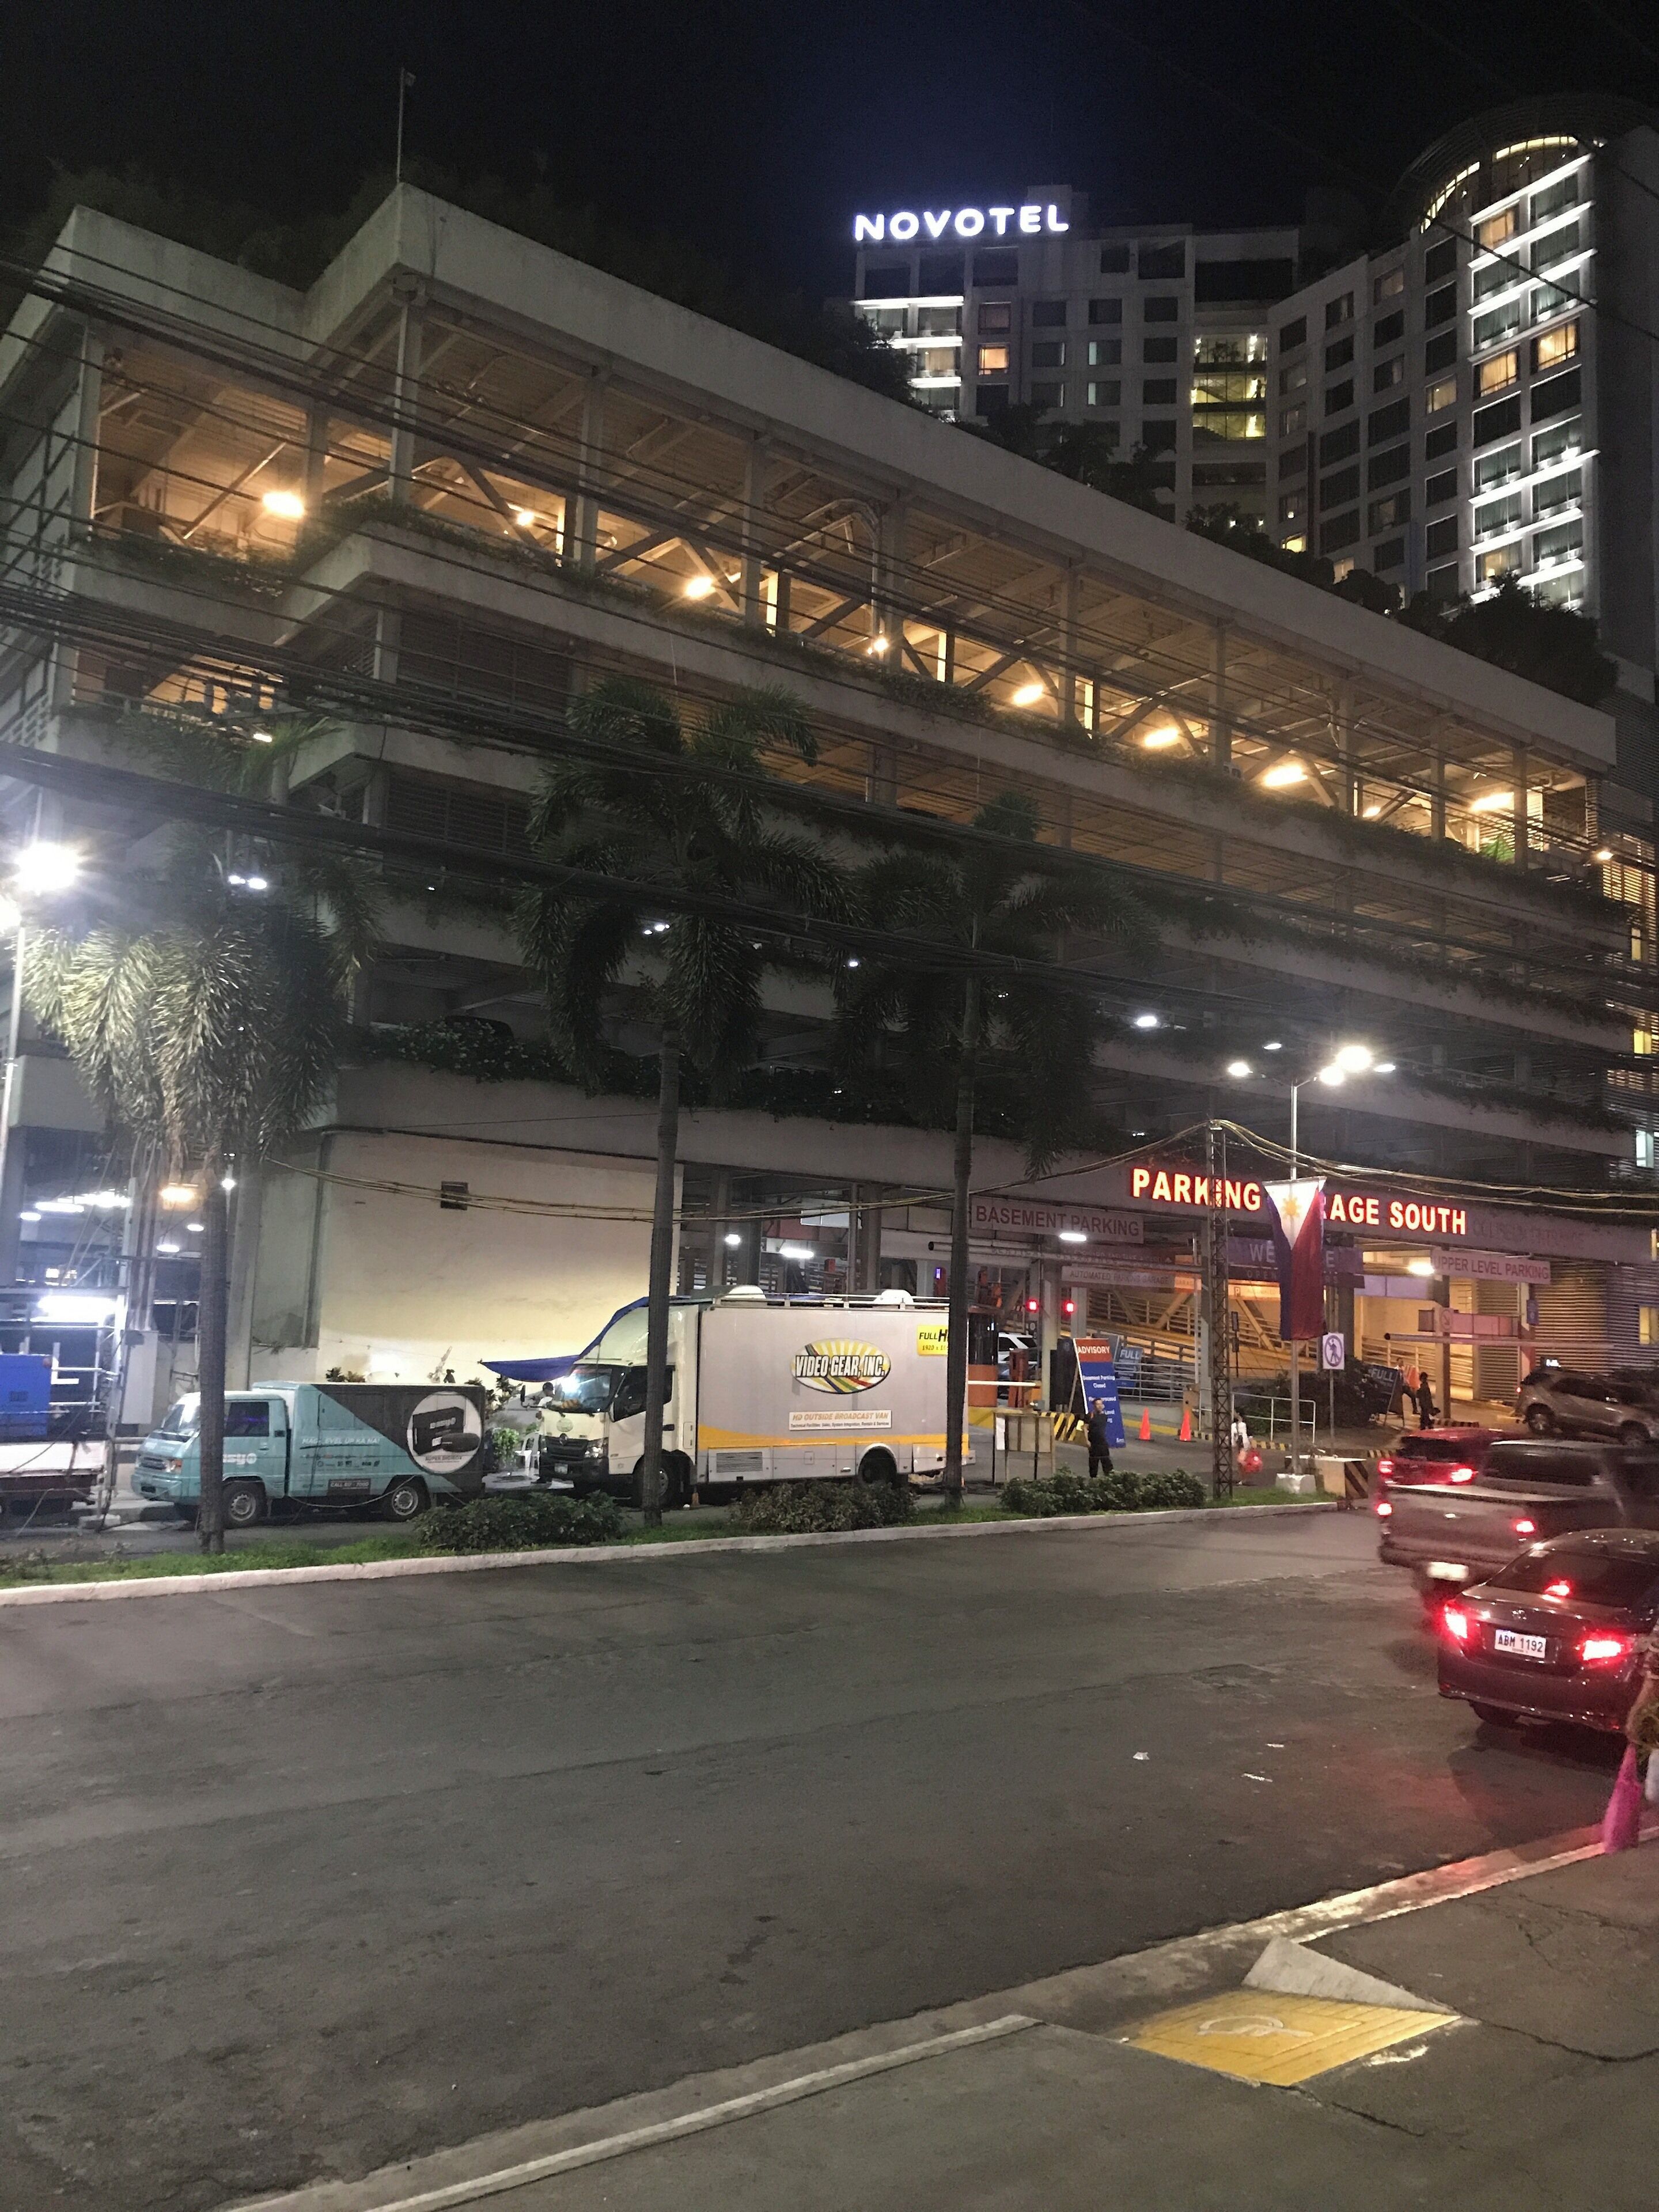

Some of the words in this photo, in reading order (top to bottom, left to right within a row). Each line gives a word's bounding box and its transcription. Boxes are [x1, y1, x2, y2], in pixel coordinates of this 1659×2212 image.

[854, 204, 1069, 241] NOVOTEL
[1132, 1168, 1261, 1211] PARKING
[1323, 1194, 1379, 1225] AGE
[1390, 1201, 1466, 1235] SOUTH
[976, 1205, 1065, 1228] BASEMENT
[1071, 1215, 1139, 1236] PARKING
[1070, 1270, 1111, 1281] AUTOMATED
[1434, 1255, 1468, 1271] UPPER
[1471, 1260, 1502, 1275] LEVEL
[1505, 1263, 1548, 1279] PARKING
[938, 1329, 948, 1342] H
[1120, 1349, 1139, 1359] FULL
[796, 1355, 830, 1377] VIDEO
[863, 1355, 885, 1377] INC.
[1372, 1368, 1394, 1382] FULL
[1498, 1634, 1516, 1647] ABM
[1520, 1638, 1543, 1653] 1192
